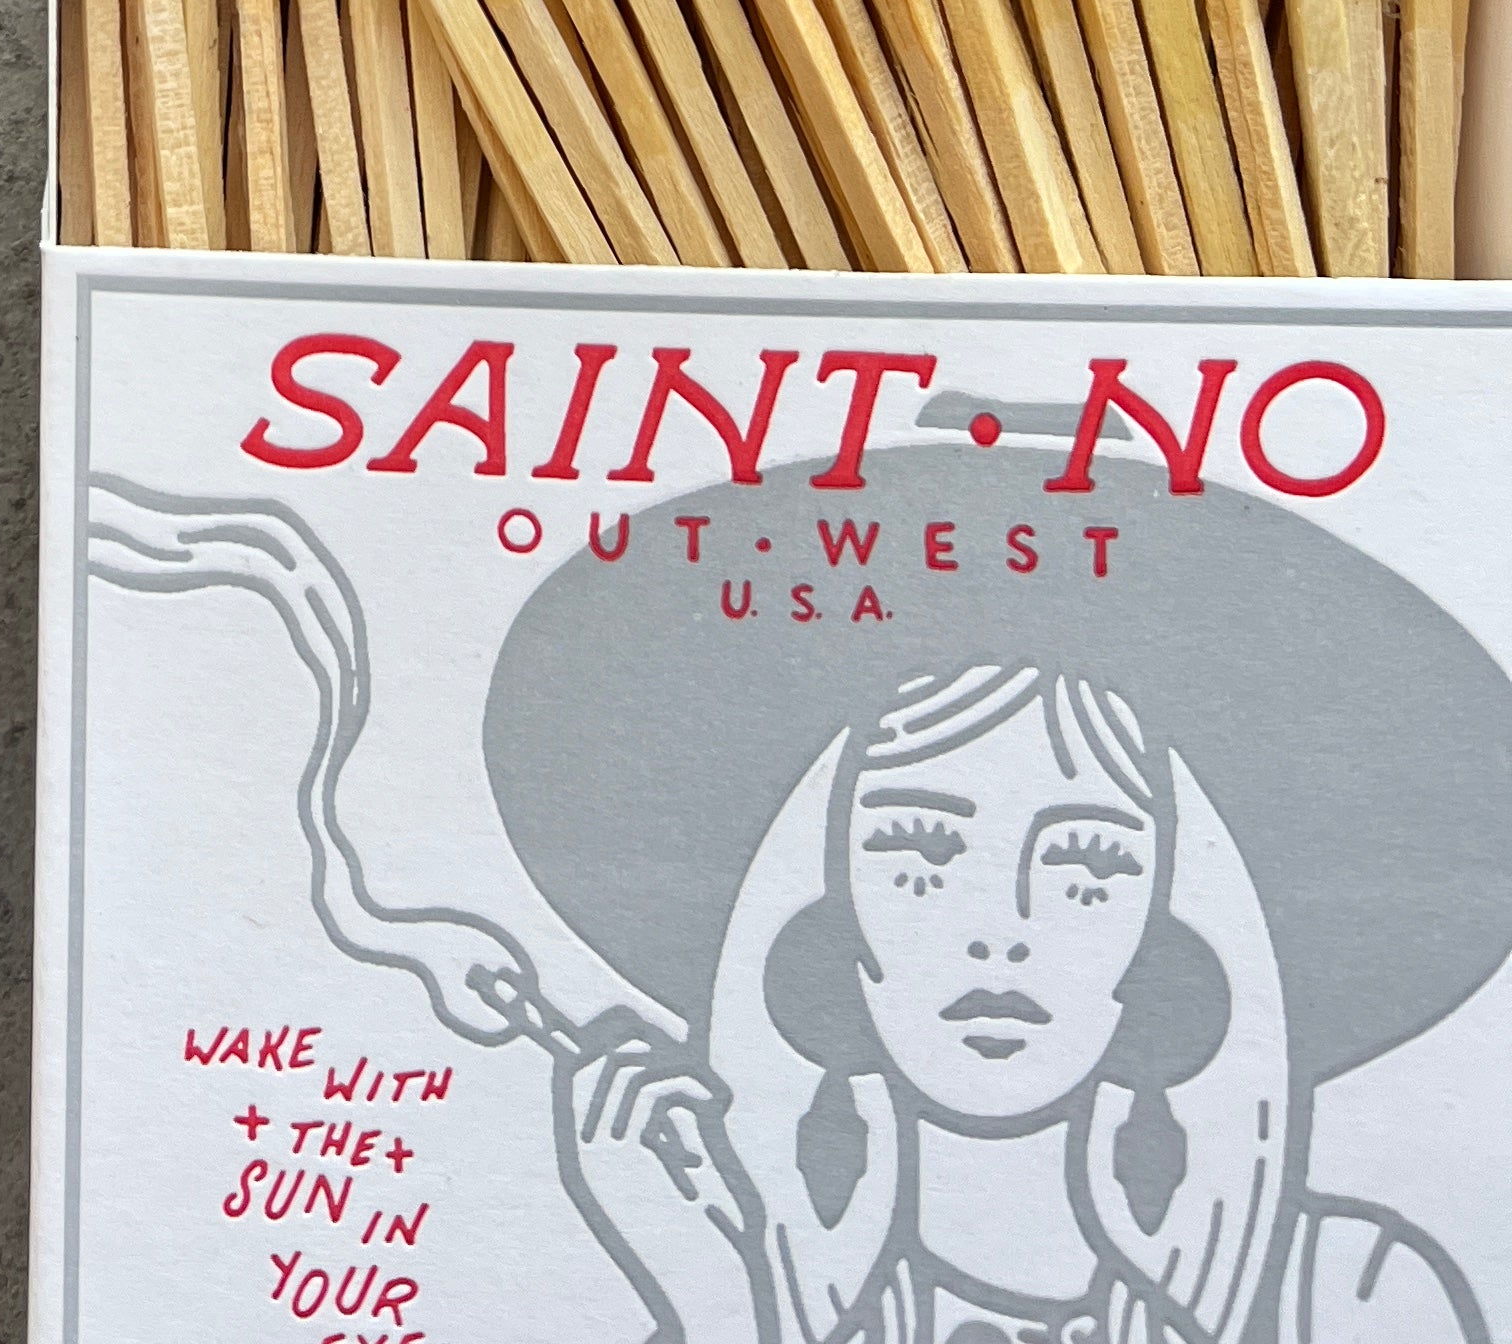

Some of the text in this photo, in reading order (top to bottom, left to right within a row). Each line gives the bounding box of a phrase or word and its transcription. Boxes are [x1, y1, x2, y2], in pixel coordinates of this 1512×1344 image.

[241, 335, 1385, 497] SAINT NO
[498, 510, 1117, 577] OUT WEST
[185, 1025, 452, 1102] WAKE WITH
[292, 1122, 380, 1166] THE
[223, 1159, 428, 1245] SUN IN
[272, 1252, 417, 1325] YOUR
